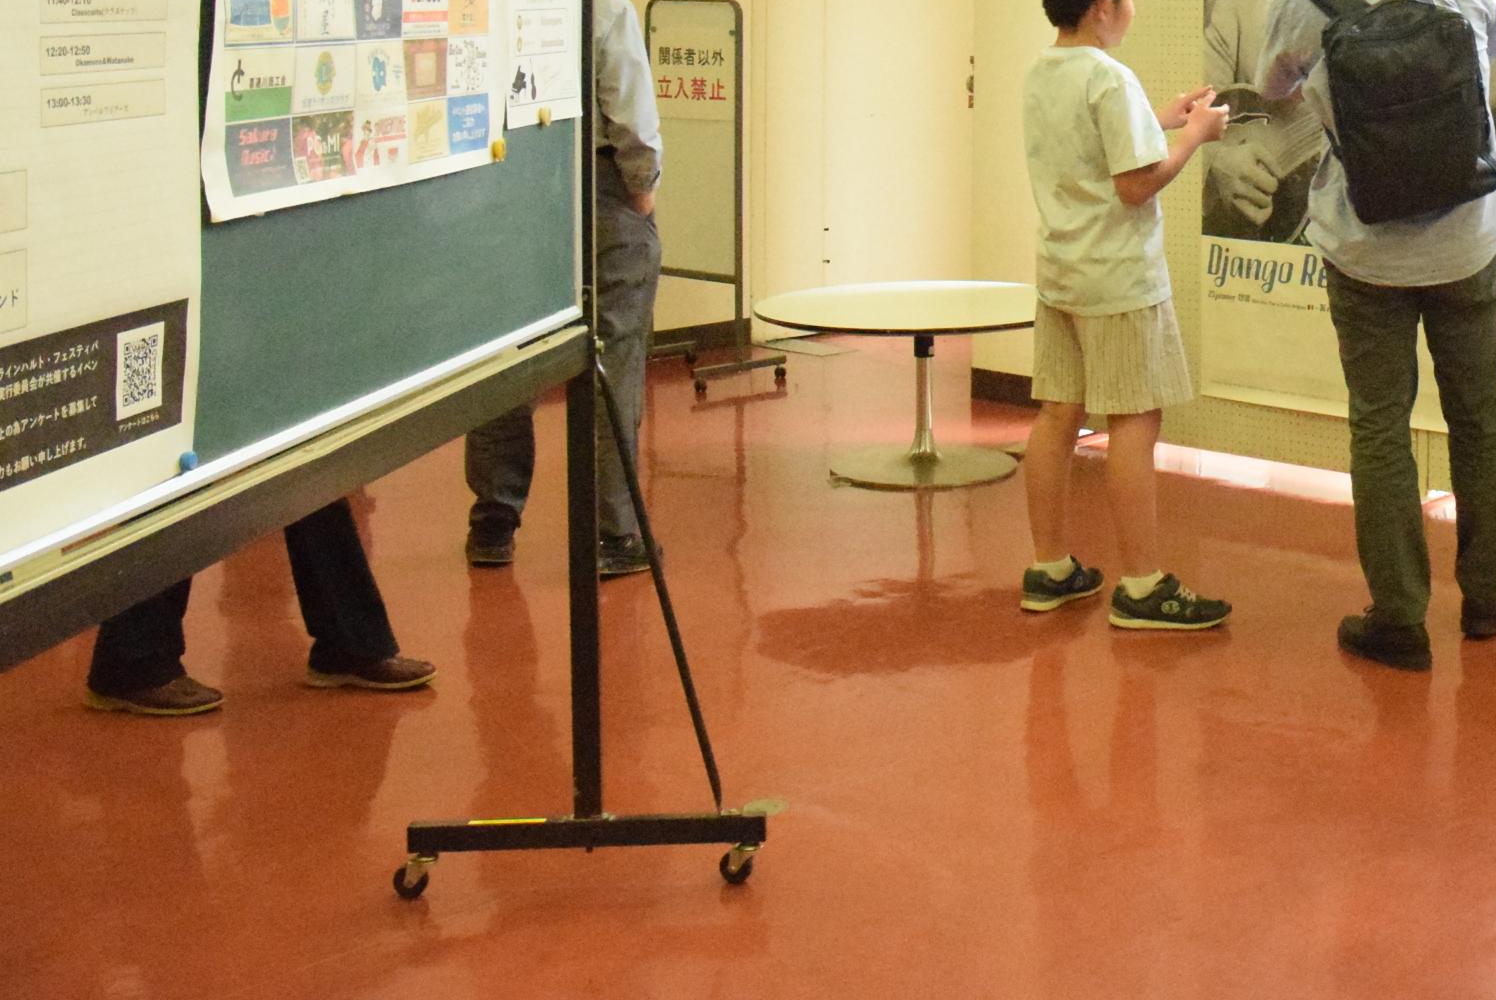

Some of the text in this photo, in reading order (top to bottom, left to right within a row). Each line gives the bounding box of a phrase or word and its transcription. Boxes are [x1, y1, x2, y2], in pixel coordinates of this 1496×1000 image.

[46, 44, 91, 57] 12:20-12:50
[658, 46, 725, 67] 関係者以外
[656, 75, 727, 101] 立入禁止
[47, 95, 92, 109] 13:00-13:30
[1207, 243, 1294, 293] Django
